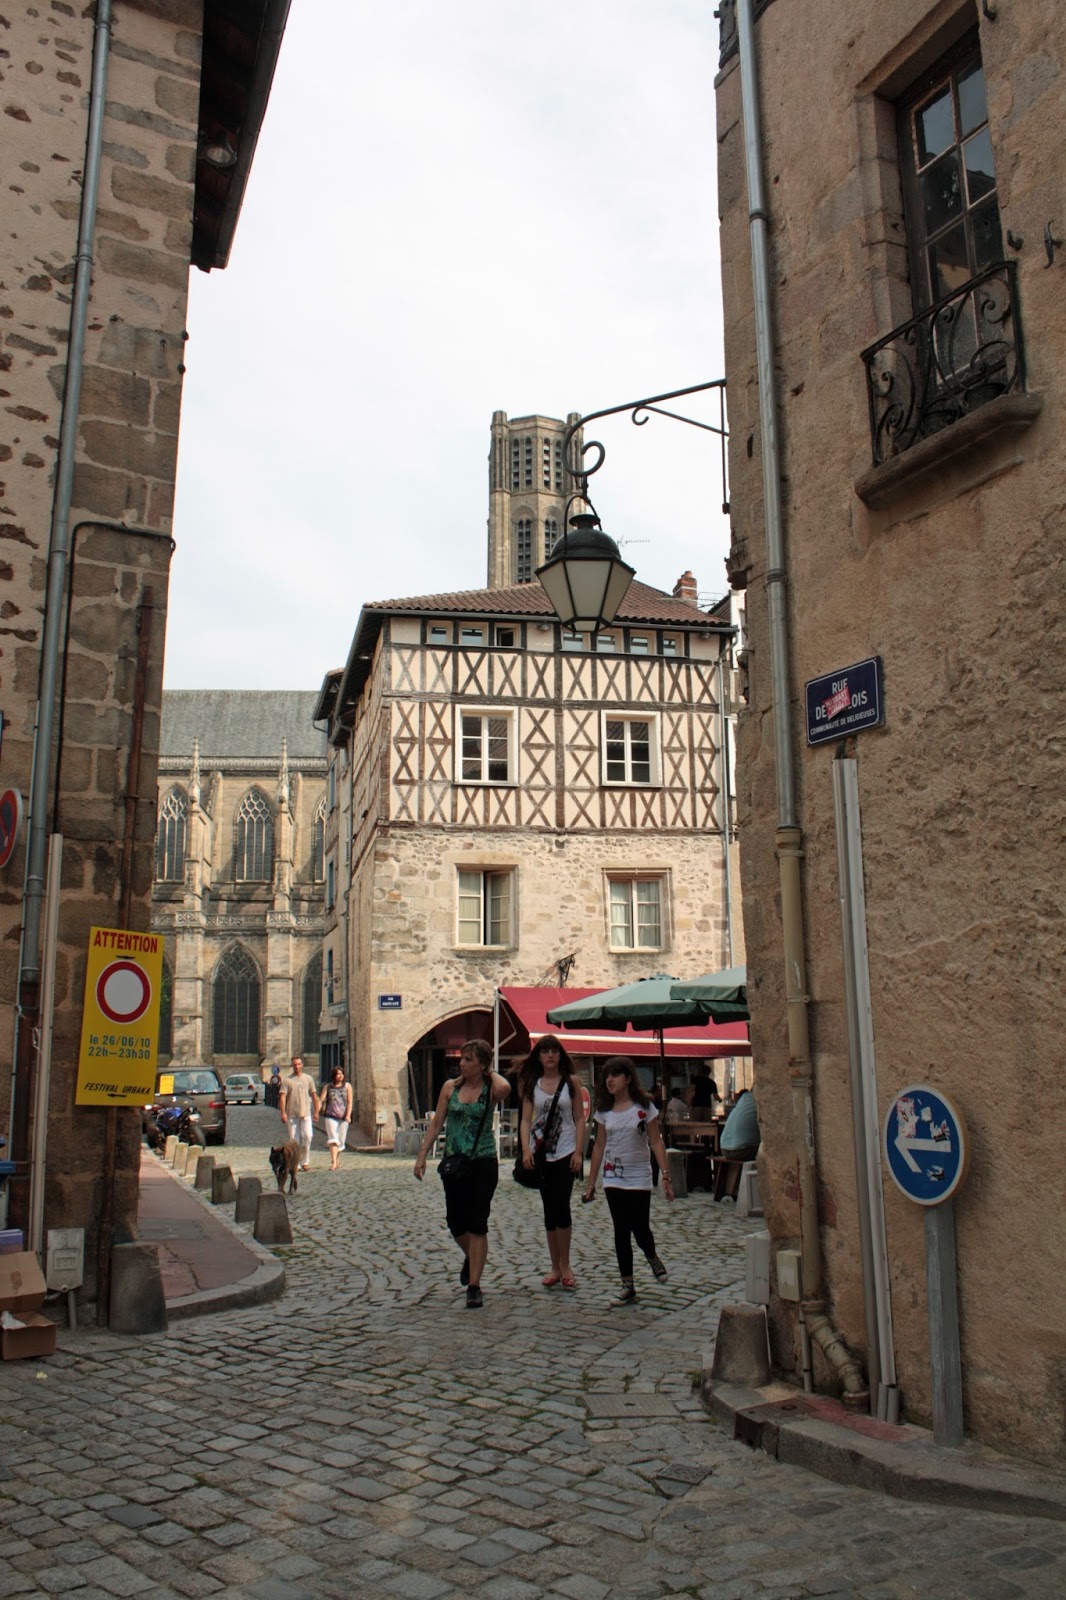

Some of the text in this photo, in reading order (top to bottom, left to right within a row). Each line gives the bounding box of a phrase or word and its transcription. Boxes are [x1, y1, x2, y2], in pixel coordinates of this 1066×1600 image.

[831, 677, 848, 694] RUE
[810, 708, 875, 735] COMMUNAUTÉ DE RELIGIEUSES
[93, 930, 158, 953] ATTENTION
[89, 1034, 151, 1048] le 26/06/10
[84, 1082, 120, 1094] FESTIVAL
[122, 1083, 151, 1095] URBAKA
